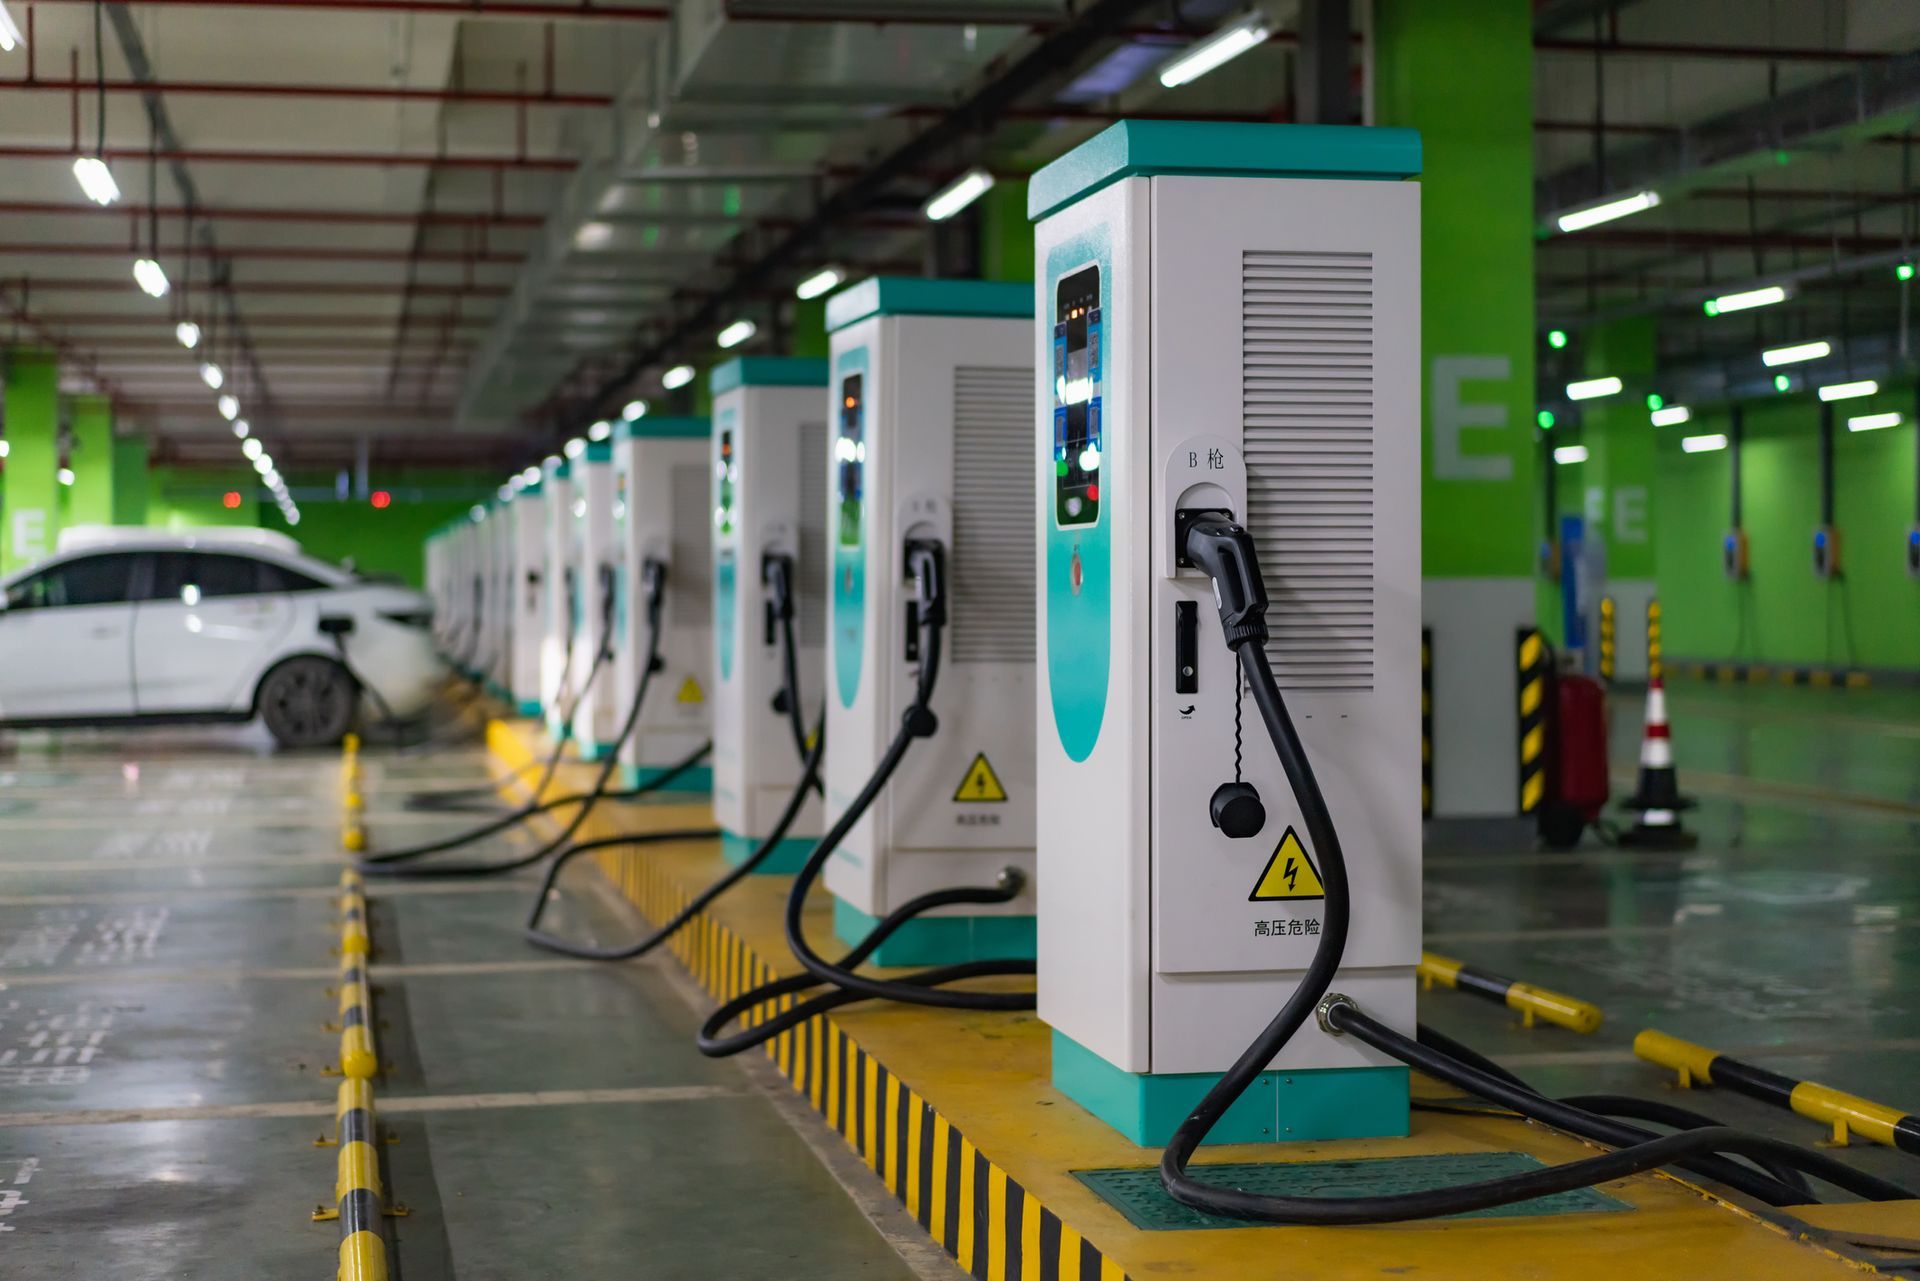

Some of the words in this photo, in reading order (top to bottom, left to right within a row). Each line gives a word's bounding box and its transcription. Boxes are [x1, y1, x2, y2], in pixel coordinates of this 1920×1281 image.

[1432, 355, 1513, 480] E
[1189, 451, 1198, 468] B
[1207, 448, 1224, 470] 枪
[13, 509, 46, 557] E
[1614, 488, 1648, 542] E
[1254, 918, 1320, 937] 高压危险
